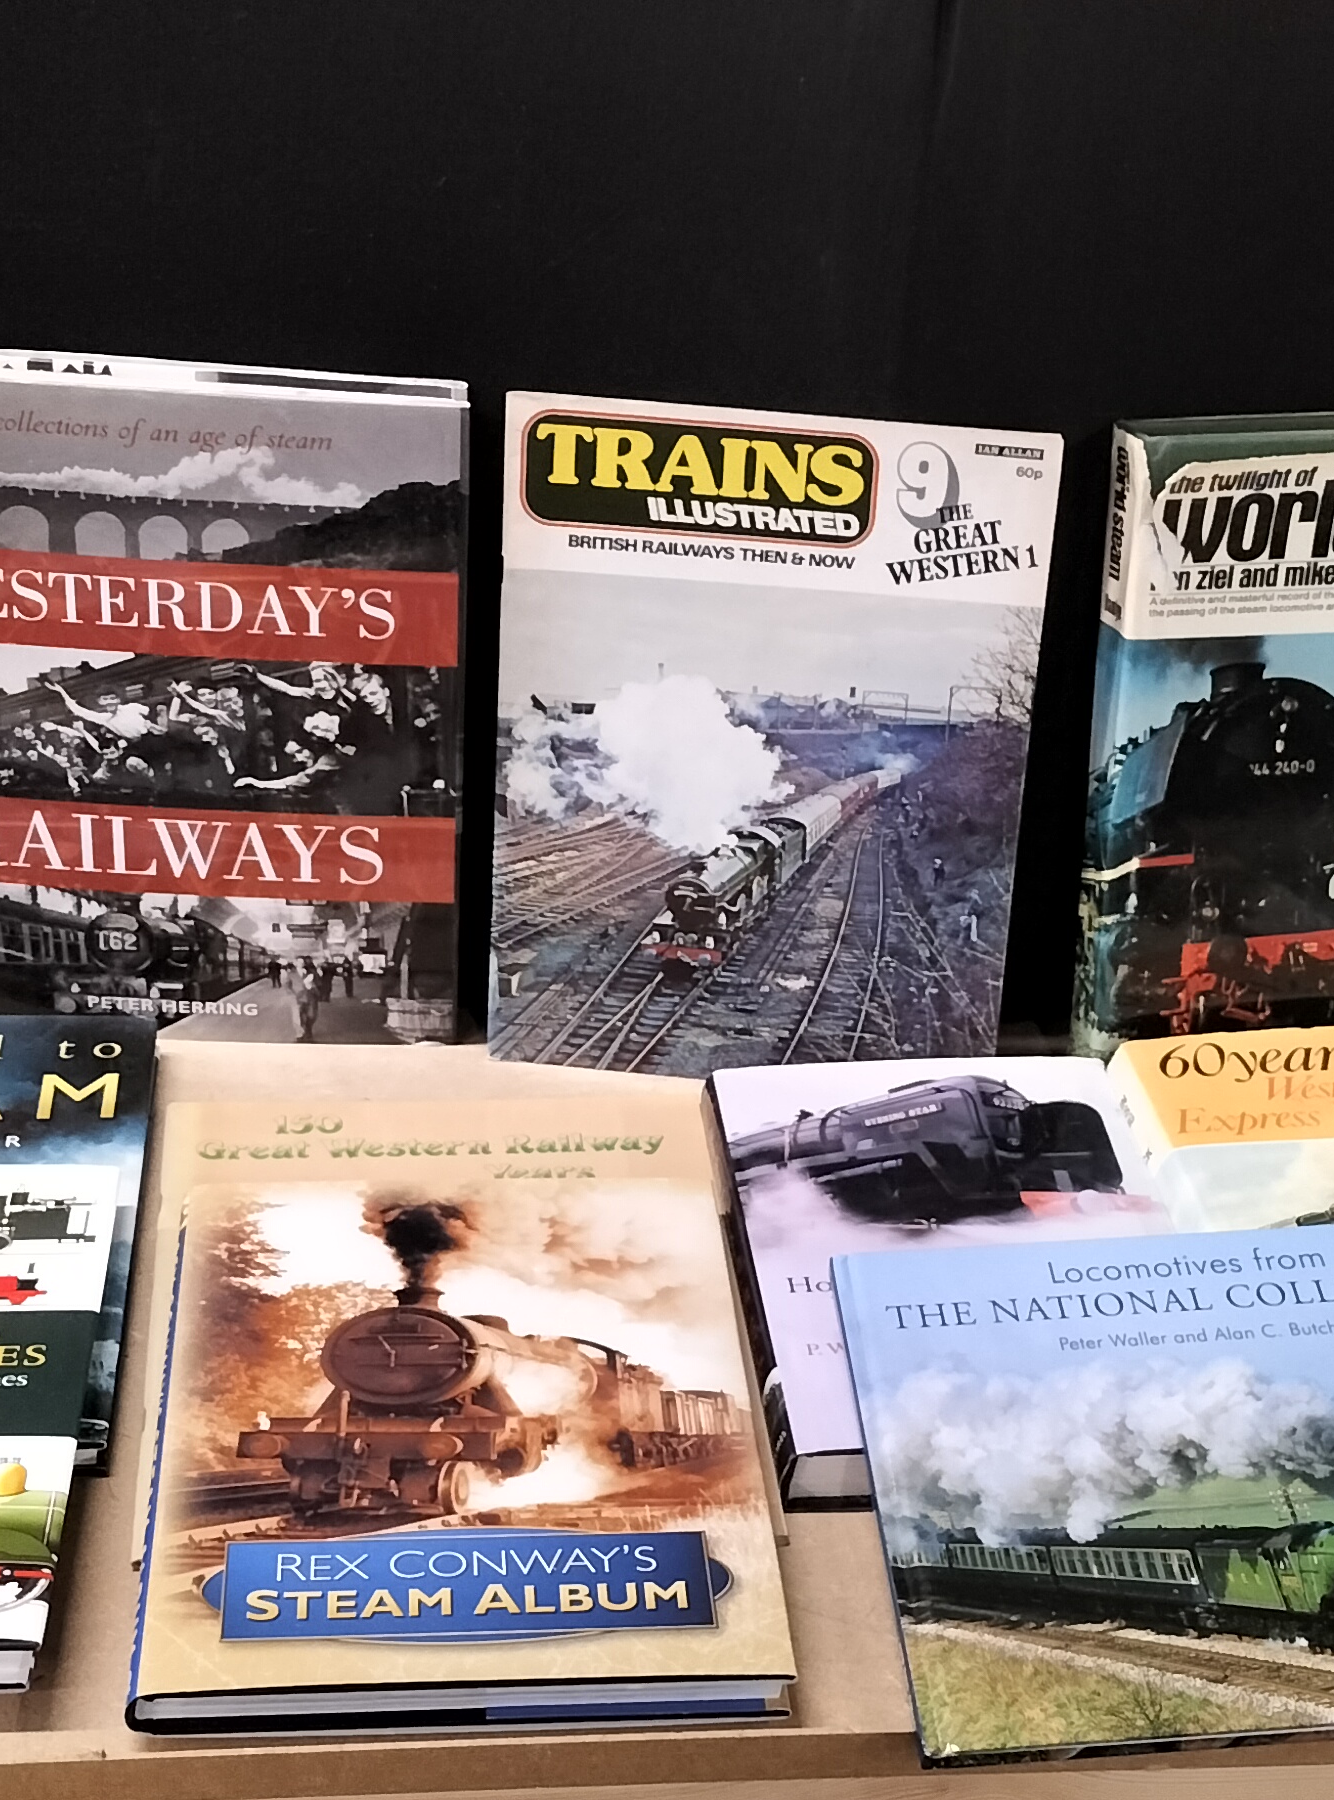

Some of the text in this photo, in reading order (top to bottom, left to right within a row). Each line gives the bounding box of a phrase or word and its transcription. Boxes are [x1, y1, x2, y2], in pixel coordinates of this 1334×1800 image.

[117, 416, 146, 447] of
[149, 424, 179, 444] an
[187, 426, 228, 454] age
[234, 424, 266, 455] of
[266, 431, 334, 452] steam
[535, 421, 865, 507] TRAINS
[978, 445, 1042, 459] IAN ALLAN
[896, 440, 960, 529] 9
[1016, 466, 1044, 481] 60p
[1209, 468, 1292, 493] twilight
[1295, 466, 1319, 487] of
[646, 496, 861, 538] ILLUSTRATED
[935, 503, 974, 524] THE
[567, 534, 857, 571] BRITISH RAILWAYS THEN & NOW
[913, 519, 1004, 555] GREAT
[1108, 515, 1124, 581] steam
[885, 545, 1041, 587] WESTERN 1
[1196, 565, 1235, 591] ziel
[1239, 563, 1280, 589] and
[1166, 607, 1206, 619] passing
[1237, 605, 1268, 614] steam
[1269, 603, 1324, 613] locomotive
[1207, 594, 1227, 604] and
[1277, 591, 1310, 601] record
[87, 995, 259, 1017] PETER HERRING
[57, 1037, 124, 1061] to
[274, 1113, 344, 1136] 150
[1175, 1104, 1322, 1136] Express
[196, 1130, 664, 1161] Great Western Railway
[484, 1163, 596, 1180] Years
[1047, 1247, 1327, 1286] Locomotives from
[884, 1301, 978, 1331] THE
[992, 1286, 1215, 1325] NATIONAL
[1059, 1333, 1103, 1353] Peter
[1109, 1329, 1168, 1350] Waller
[1173, 1326, 1209, 1346] and
[1214, 1323, 1256, 1342] Alan
[1260, 1322, 1283, 1340] C.
[275, 1544, 658, 1582] REX CONWAY'S
[244, 1578, 691, 1623] STEAM ALBUM
